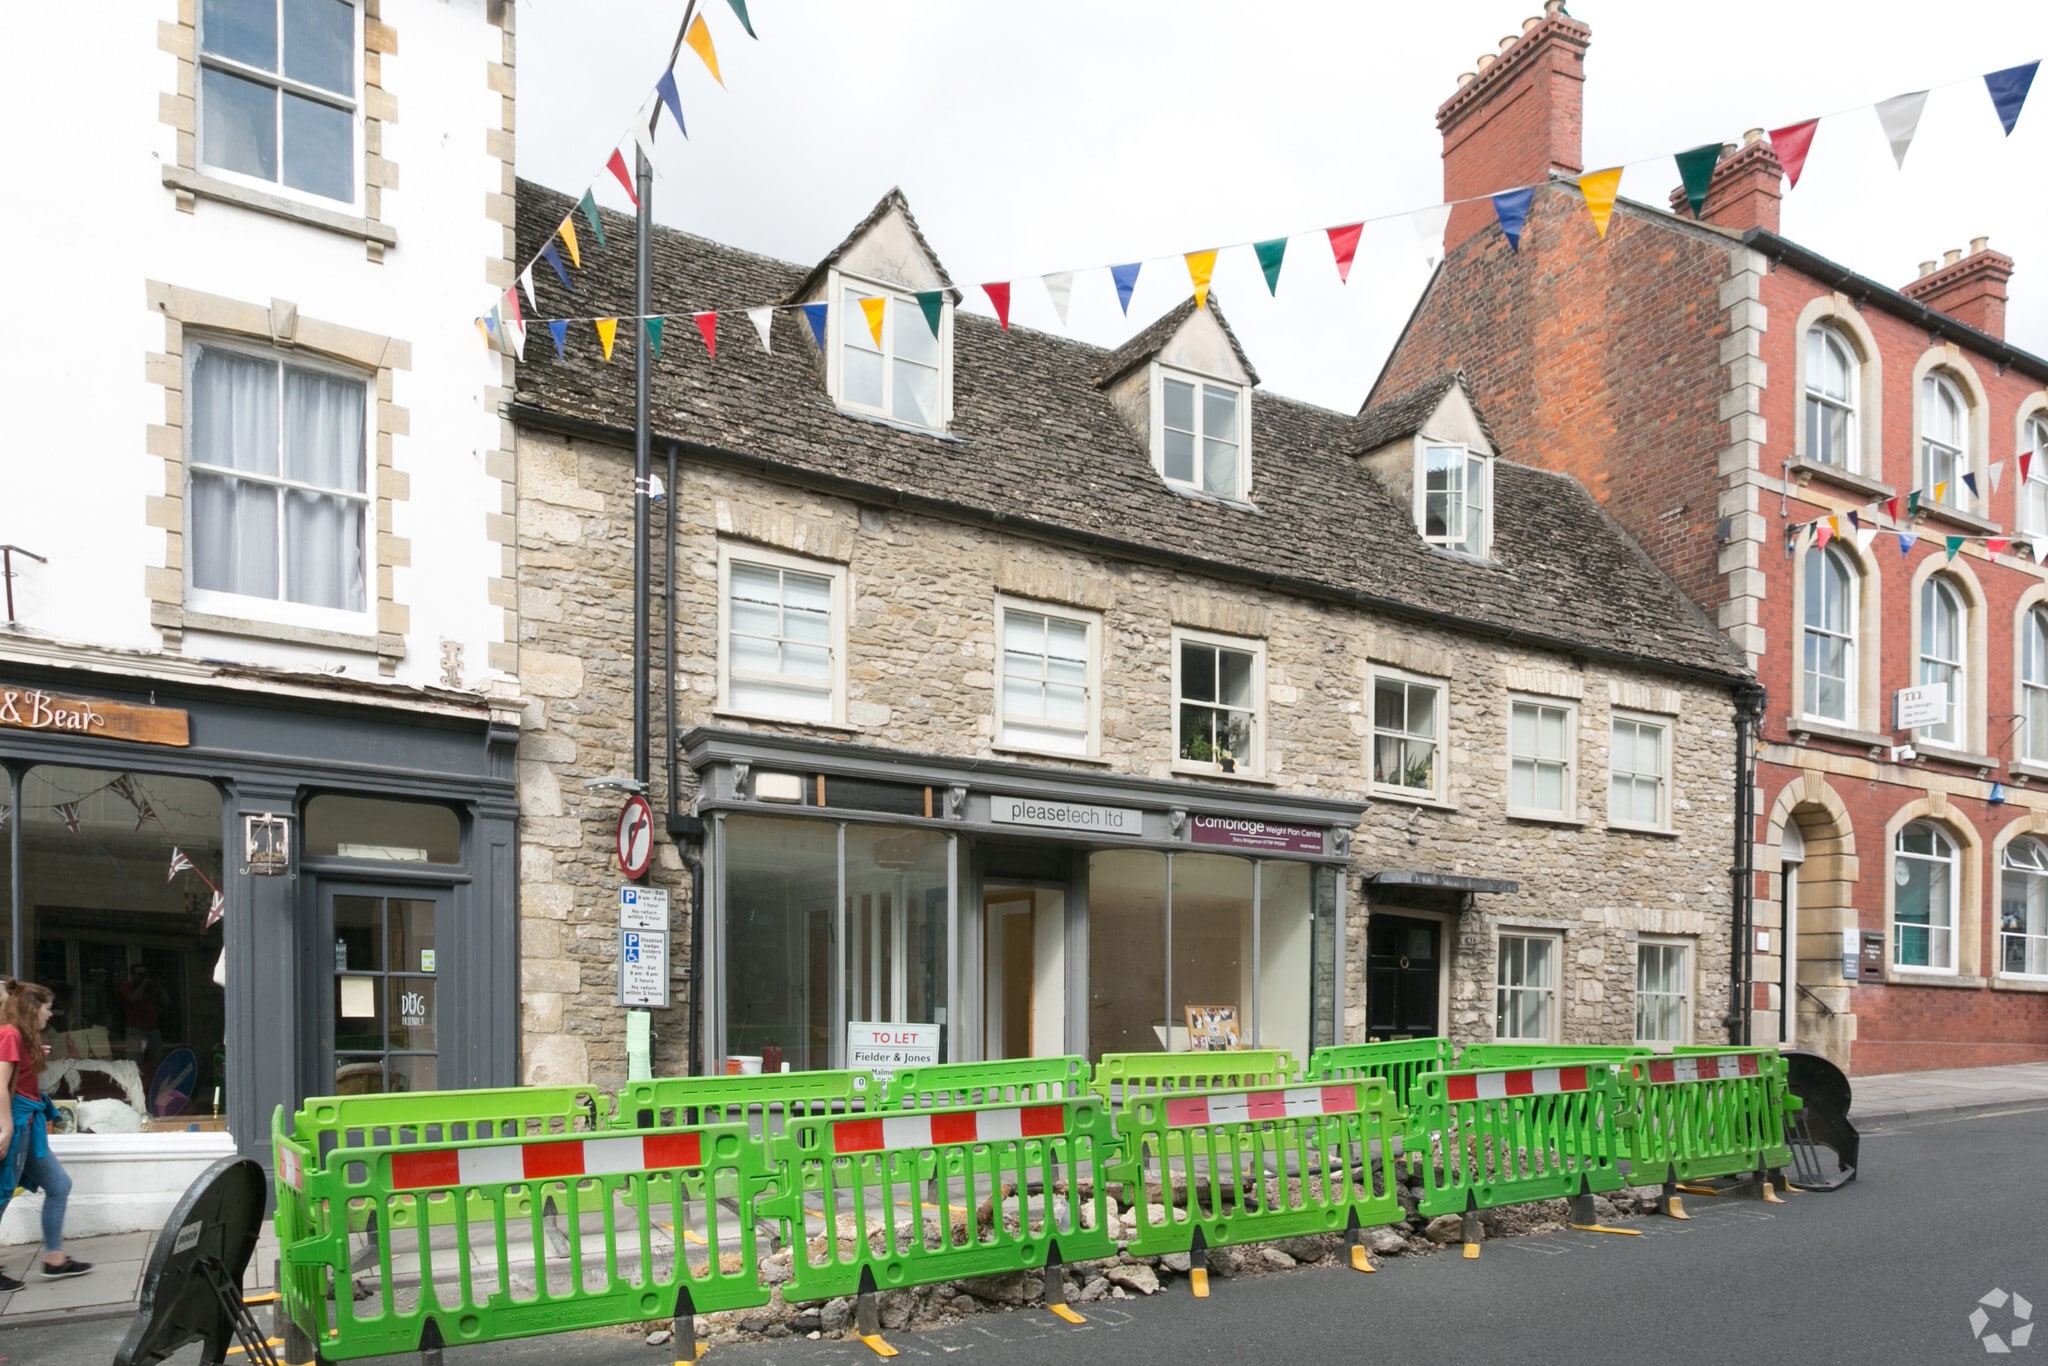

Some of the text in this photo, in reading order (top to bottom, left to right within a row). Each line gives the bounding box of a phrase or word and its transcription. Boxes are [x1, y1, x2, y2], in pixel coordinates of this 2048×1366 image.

[0, 690, 104, 730] & Bear
[1012, 801, 1123, 827] pleasetech ltd
[1195, 814, 1322, 838] Cambridge Weight Plan Centre
[401, 992, 425, 1016] DOG
[401, 1016, 424, 1026] FRIENDLY
[872, 1032, 918, 1044] TO LET
[855, 1051, 931, 1063] Fielder & Jones
